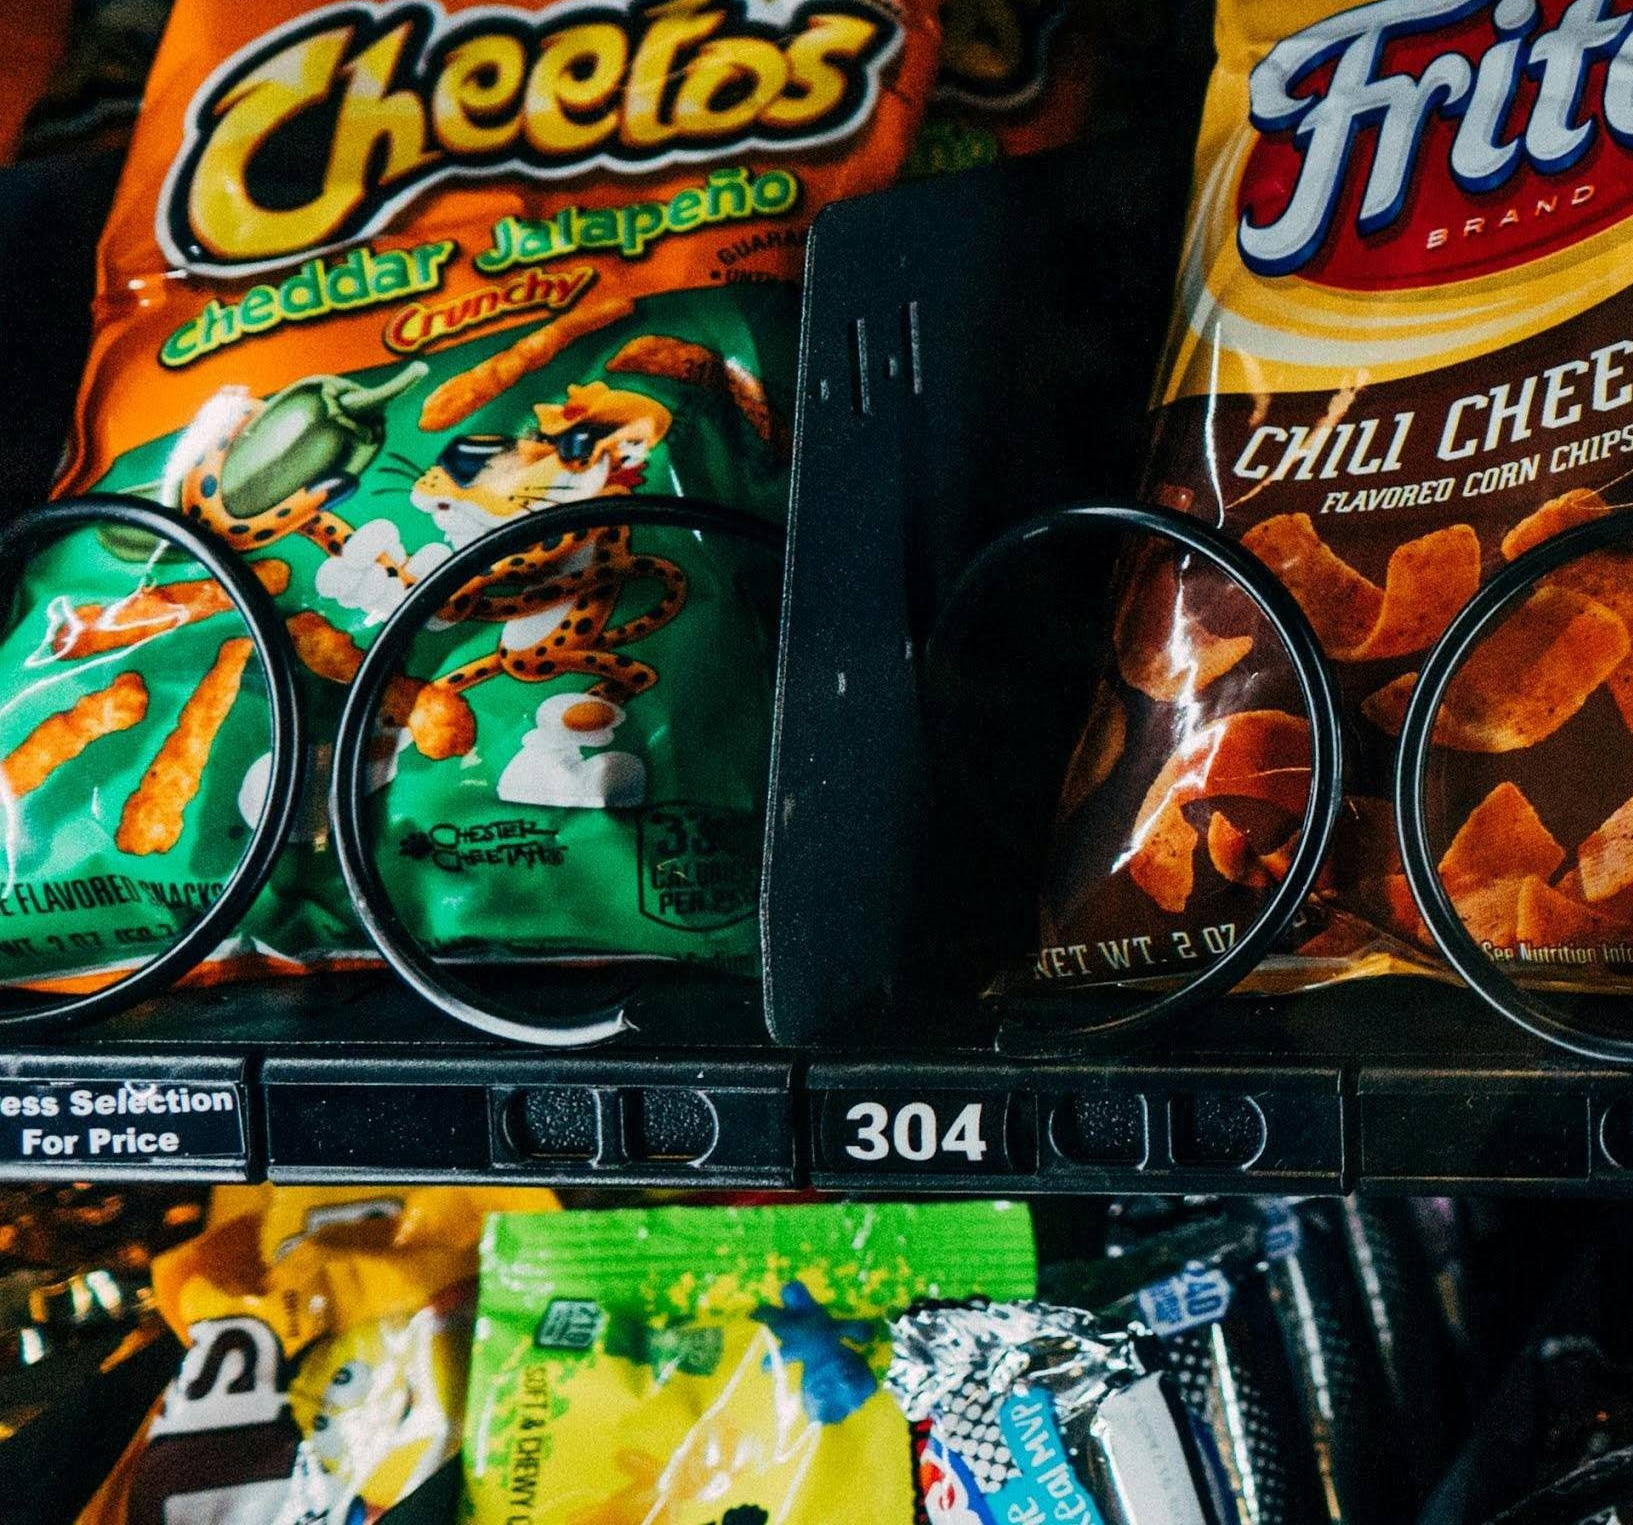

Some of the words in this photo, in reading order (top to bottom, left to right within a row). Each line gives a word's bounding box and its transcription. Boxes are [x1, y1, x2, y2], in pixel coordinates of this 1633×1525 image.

[474, 167, 799, 271] Jalapeño
[1425, 185, 1597, 250] BRAND
[160, 239, 456, 366] cheddar
[385, 265, 598, 353] Crunchy
[1233, 404, 1416, 484] CHILI
[1320, 475, 1455, 516] FLAVORED
[1461, 455, 1541, 501] CORN
[14, 873, 141, 916] FLAVORED
[1171, 930, 1198, 960] 2
[69, 1087, 234, 1117] Selection
[842, 1101, 988, 1163] 304
[21, 1128, 79, 1156] For
[88, 1127, 180, 1155] Price
[509, 1436, 542, 1510] CHEWY
